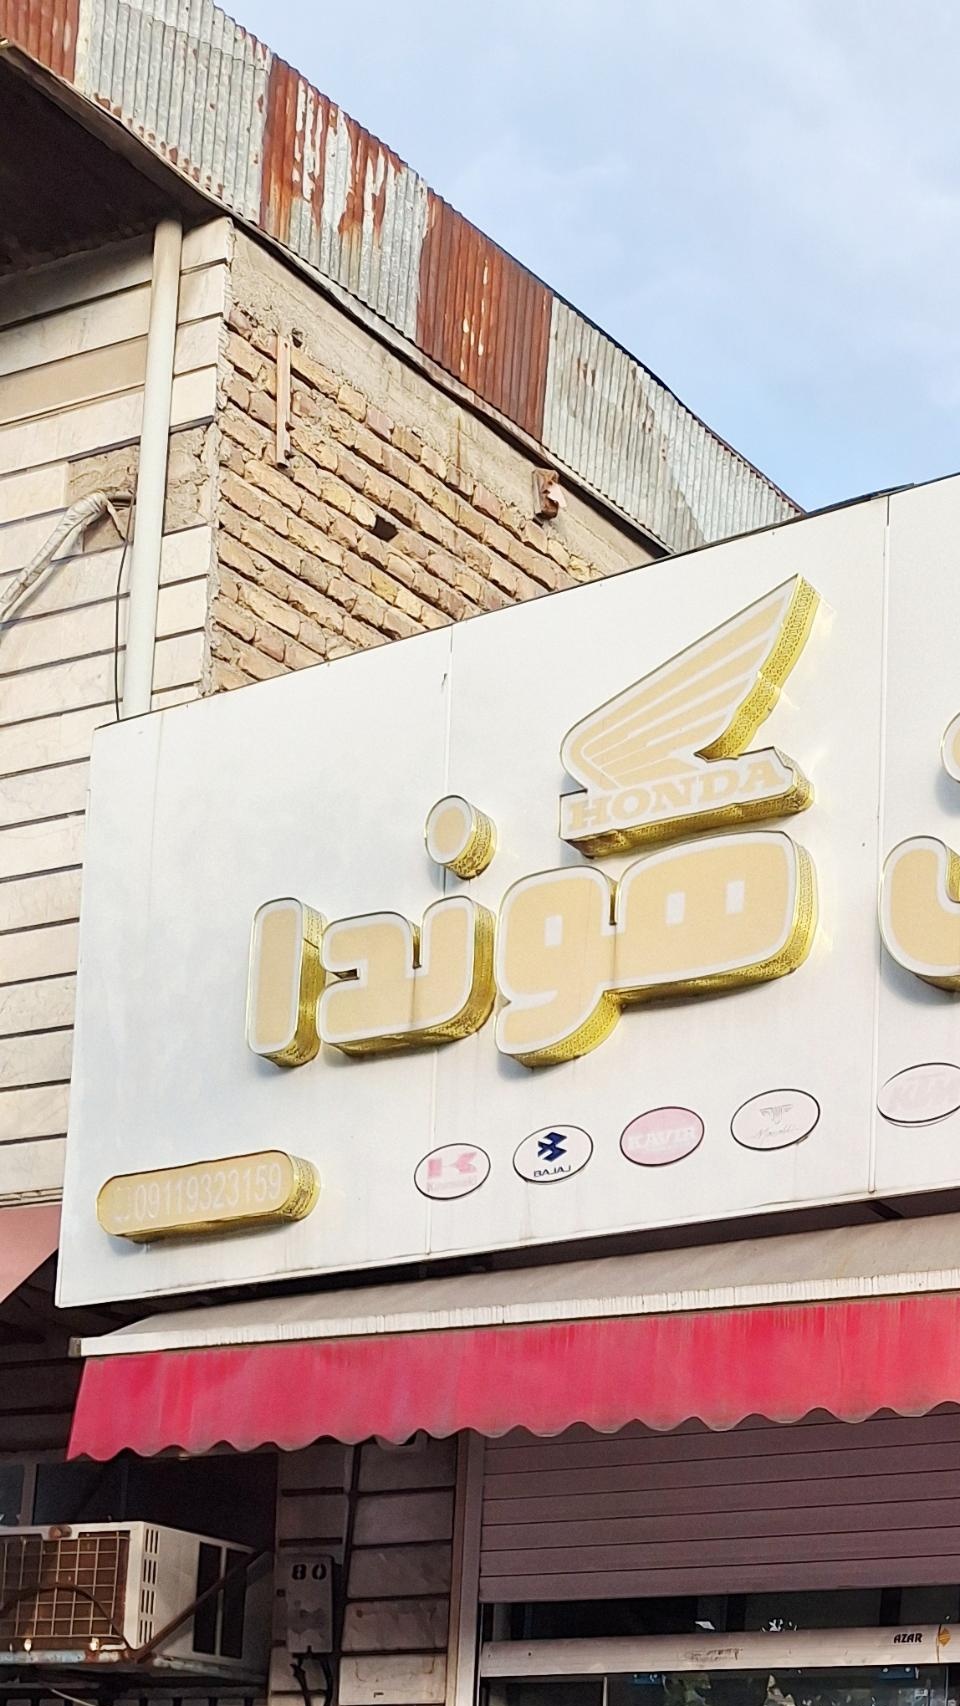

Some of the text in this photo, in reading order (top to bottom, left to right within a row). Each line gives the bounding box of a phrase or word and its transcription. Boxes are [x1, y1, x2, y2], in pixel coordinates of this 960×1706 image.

[566, 760, 786, 834] HONDA
[246, 795, 818, 1067] هوندا
[134, 1163, 282, 1220] 09119323159
[533, 1165, 571, 1178] BAJAJ
[893, 1632, 923, 1644] AZAR
